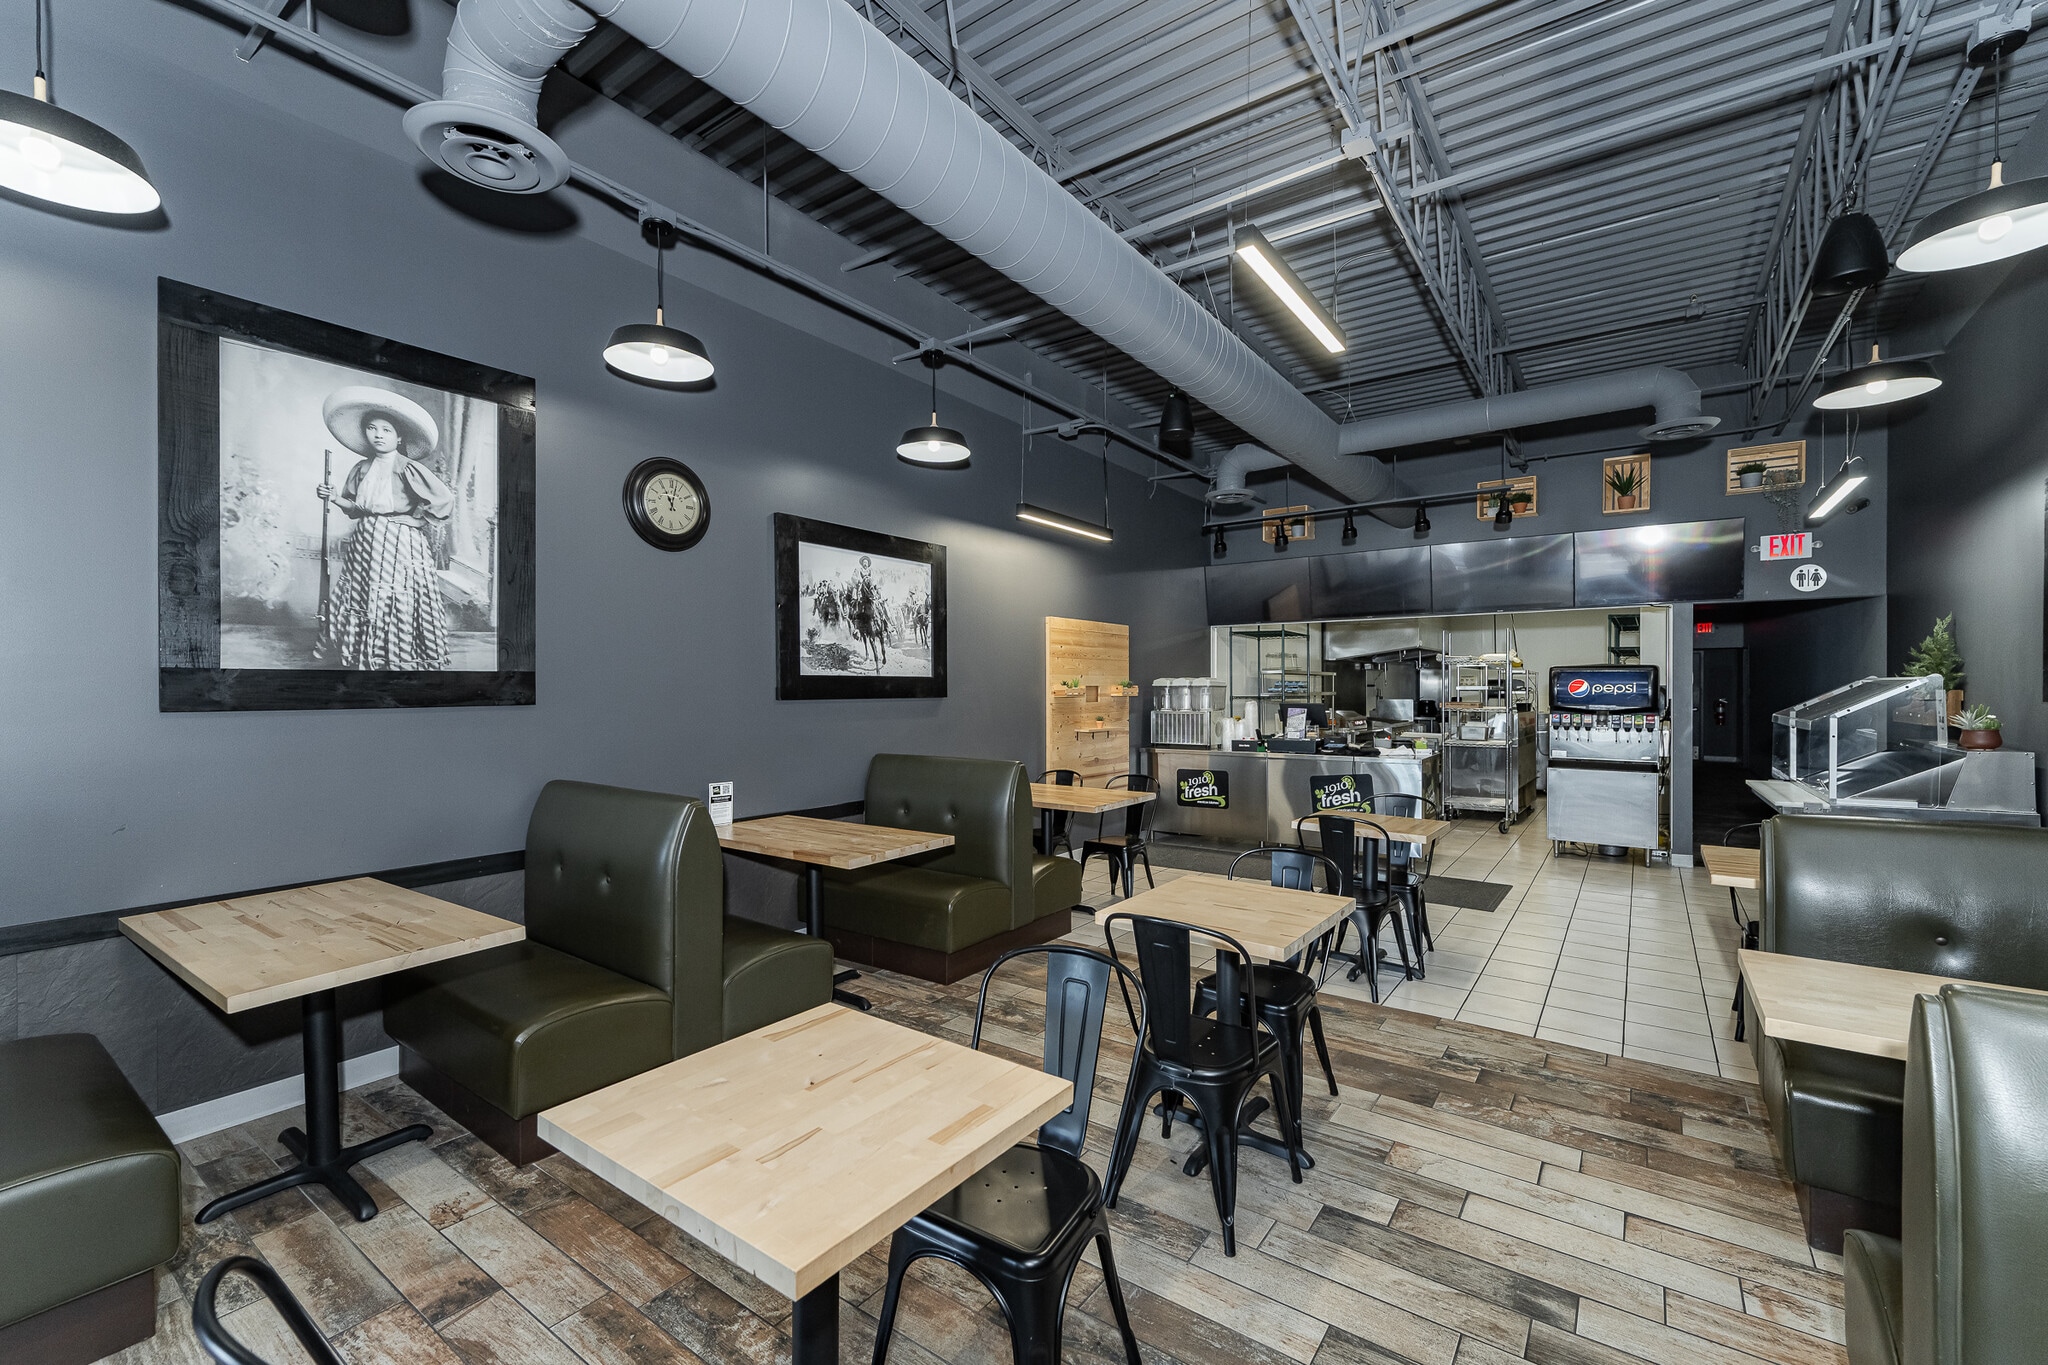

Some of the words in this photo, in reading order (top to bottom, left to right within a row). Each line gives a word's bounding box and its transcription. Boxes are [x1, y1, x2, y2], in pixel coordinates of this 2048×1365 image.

[1769, 534, 1806, 558] EXIT
[1592, 682, 1636, 695] pepsi
[1188, 776, 1208, 789] 1910
[1324, 781, 1349, 796] 1910
[1185, 784, 1218, 798] fresh
[1321, 789, 1361, 808] fresh
